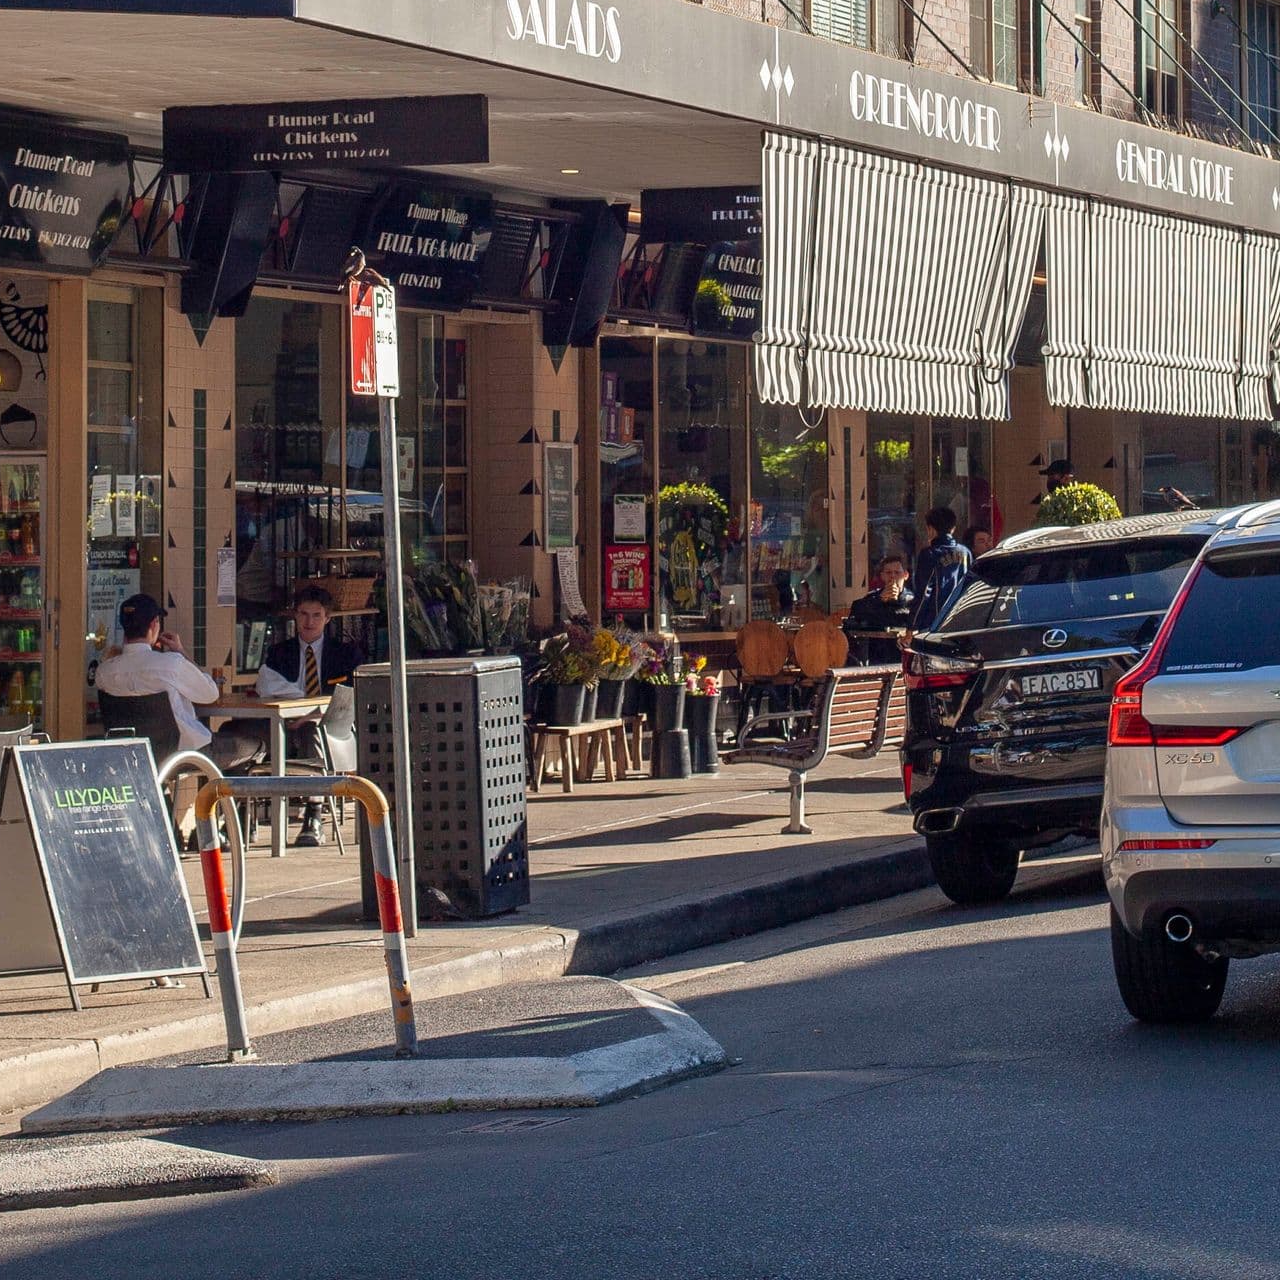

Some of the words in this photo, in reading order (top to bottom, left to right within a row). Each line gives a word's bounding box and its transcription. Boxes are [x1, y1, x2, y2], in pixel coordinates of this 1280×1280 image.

[268, 114, 329, 127] Plumer
[333, 111, 375, 125] Road
[850, 70, 1001, 153] GREENGROCER
[285, 131, 358, 145] Chickens
[15, 148, 64, 173] Plumer
[65, 155, 95, 177] Road
[1116, 138, 1187, 195] GENERAL
[1189, 157, 1234, 206] STORE
[9, 184, 82, 217] Chickens
[407, 203, 440, 221] Plumer
[441, 207, 469, 225] Village
[417, 236, 438, 257] VEG
[438, 239, 447, 258] &
[447, 241, 480, 262] MORE
[718, 254, 755, 274] GENERAL
[376, 292, 384, 318] P
[385, 293, 393, 310] 15
[54, 786, 136, 808] LILYDALE
[74, 827, 113, 835] AVAILABLE
